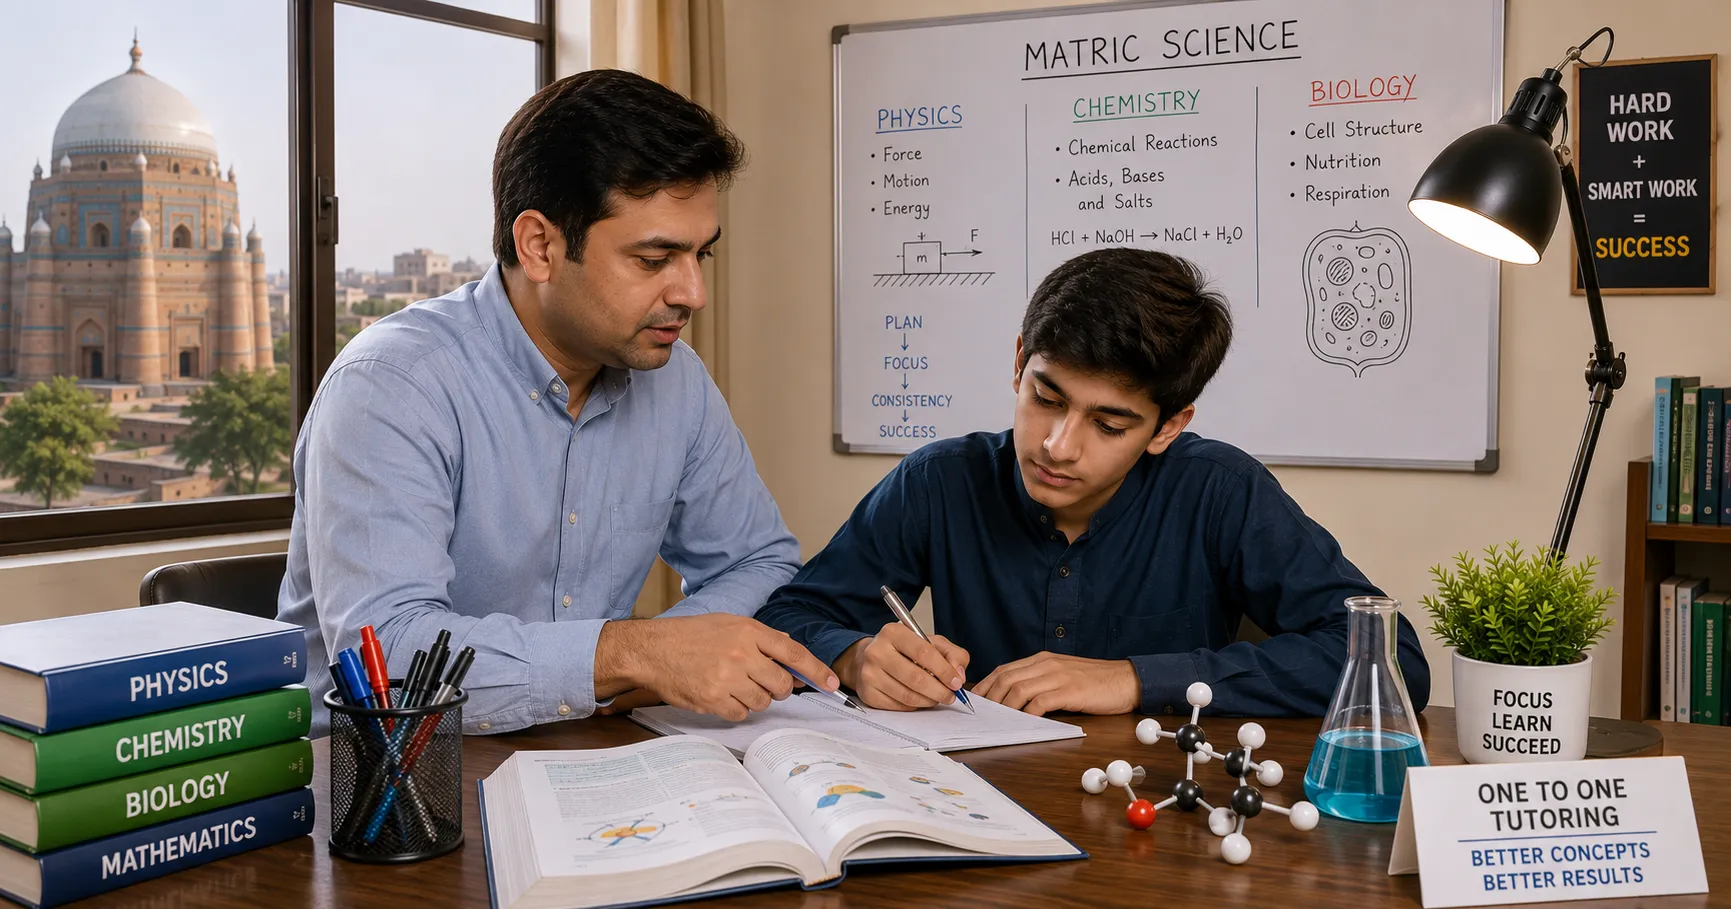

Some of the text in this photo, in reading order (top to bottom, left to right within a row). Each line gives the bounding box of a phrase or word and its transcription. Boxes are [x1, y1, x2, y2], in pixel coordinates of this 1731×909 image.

[1025, 17, 1300, 71] MATRIC SCIENCE
[1311, 74, 1417, 101] BIOLOGY
[1073, 89, 1200, 118] CHEMISTRY
[1611, 92, 1671, 114] HARD
[877, 104, 963, 130] PHYSICS
[1305, 119, 1422, 139] Cell Structure
[1607, 120, 1674, 142] WORK
[884, 146, 922, 162] Force
[1069, 134, 1217, 155] Chemical Reactions
[1306, 153, 1380, 170] Nutrition
[1633, 155, 1645, 168] +
[884, 174, 929, 188] Motion
[1069, 168, 1164, 188] Acids, Bases
[1306, 184, 1389, 206] Respiration
[1588, 179, 1697, 200] SMART WORK
[885, 201, 929, 219] Energy
[1079, 193, 1152, 210] and Salts
[1634, 214, 1645, 222] =
[971, 229, 978, 242] F
[1052, 231, 1074, 245] HCl
[1082, 234, 1089, 242] +
[1096, 229, 1134, 243] NaOH
[1165, 227, 1196, 241] NaCl
[1596, 236, 1689, 258] SUCCESS
[916, 254, 928, 263] m
[886, 315, 922, 329] PLAN
[885, 357, 928, 369] FOCUS
[872, 394, 952, 407] CONSISTENCY
[880, 425, 936, 438] SUCCESS
[129, 660, 229, 702] PHYSICS
[1494, 689, 1552, 708] FOCUS
[1493, 713, 1551, 731] LEARN
[116, 714, 245, 762] CHEMISTRY
[1483, 733, 1560, 754] SUCCEED
[126, 771, 229, 818] BIOLOGY
[1479, 779, 1627, 803] ONE TO ONE
[1490, 806, 1619, 831] TUTORING
[102, 816, 257, 880] MATHEMATICS
[1472, 842, 1650, 866] BETTER CONCEPTS
[1484, 867, 1643, 891] BETTER RESULTS
